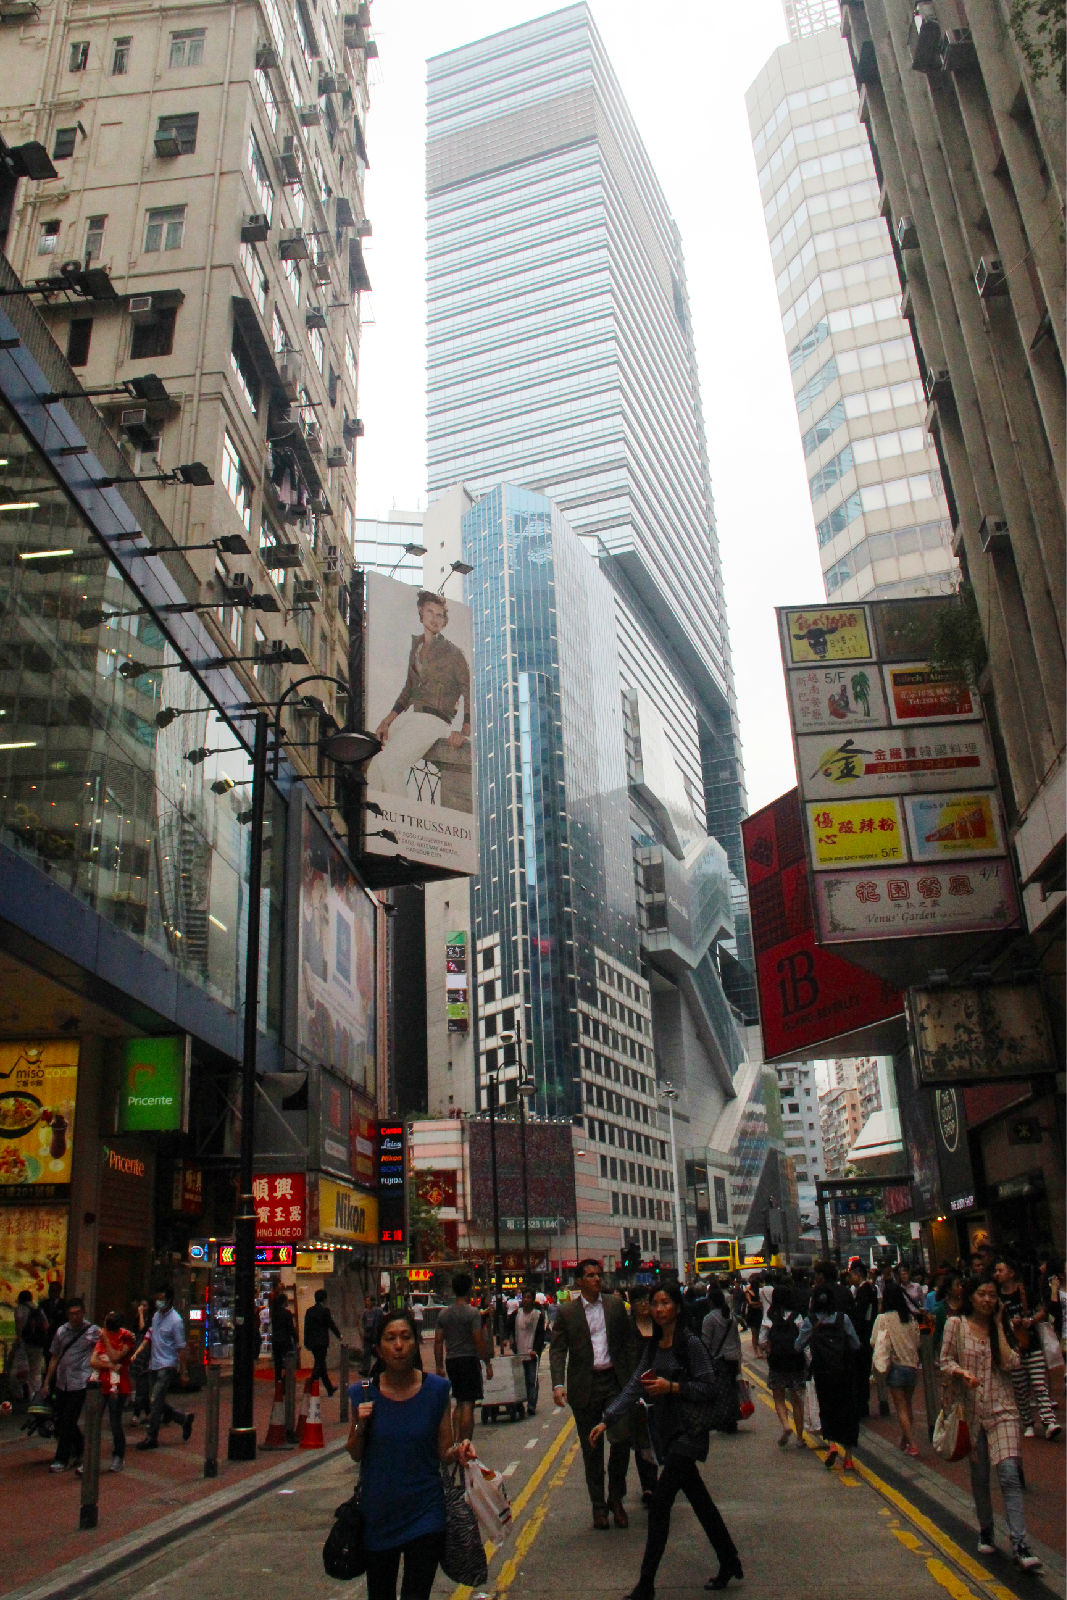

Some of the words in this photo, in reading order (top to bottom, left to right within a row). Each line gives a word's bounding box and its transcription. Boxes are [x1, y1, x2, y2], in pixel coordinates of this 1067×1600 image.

[824, 671, 846, 684] 5/F
[881, 847, 899, 858] 5/F
[856, 875, 974, 903] 花園餐廳
[128, 1096, 173, 1106] Pricente
[109, 1149, 145, 1177] Pricente
[252, 1178, 294, 1201] 順興
[335, 1191, 365, 1234] Nikon
[257, 1228, 273, 1237] HING
[273, 1227, 291, 1237] JADE
